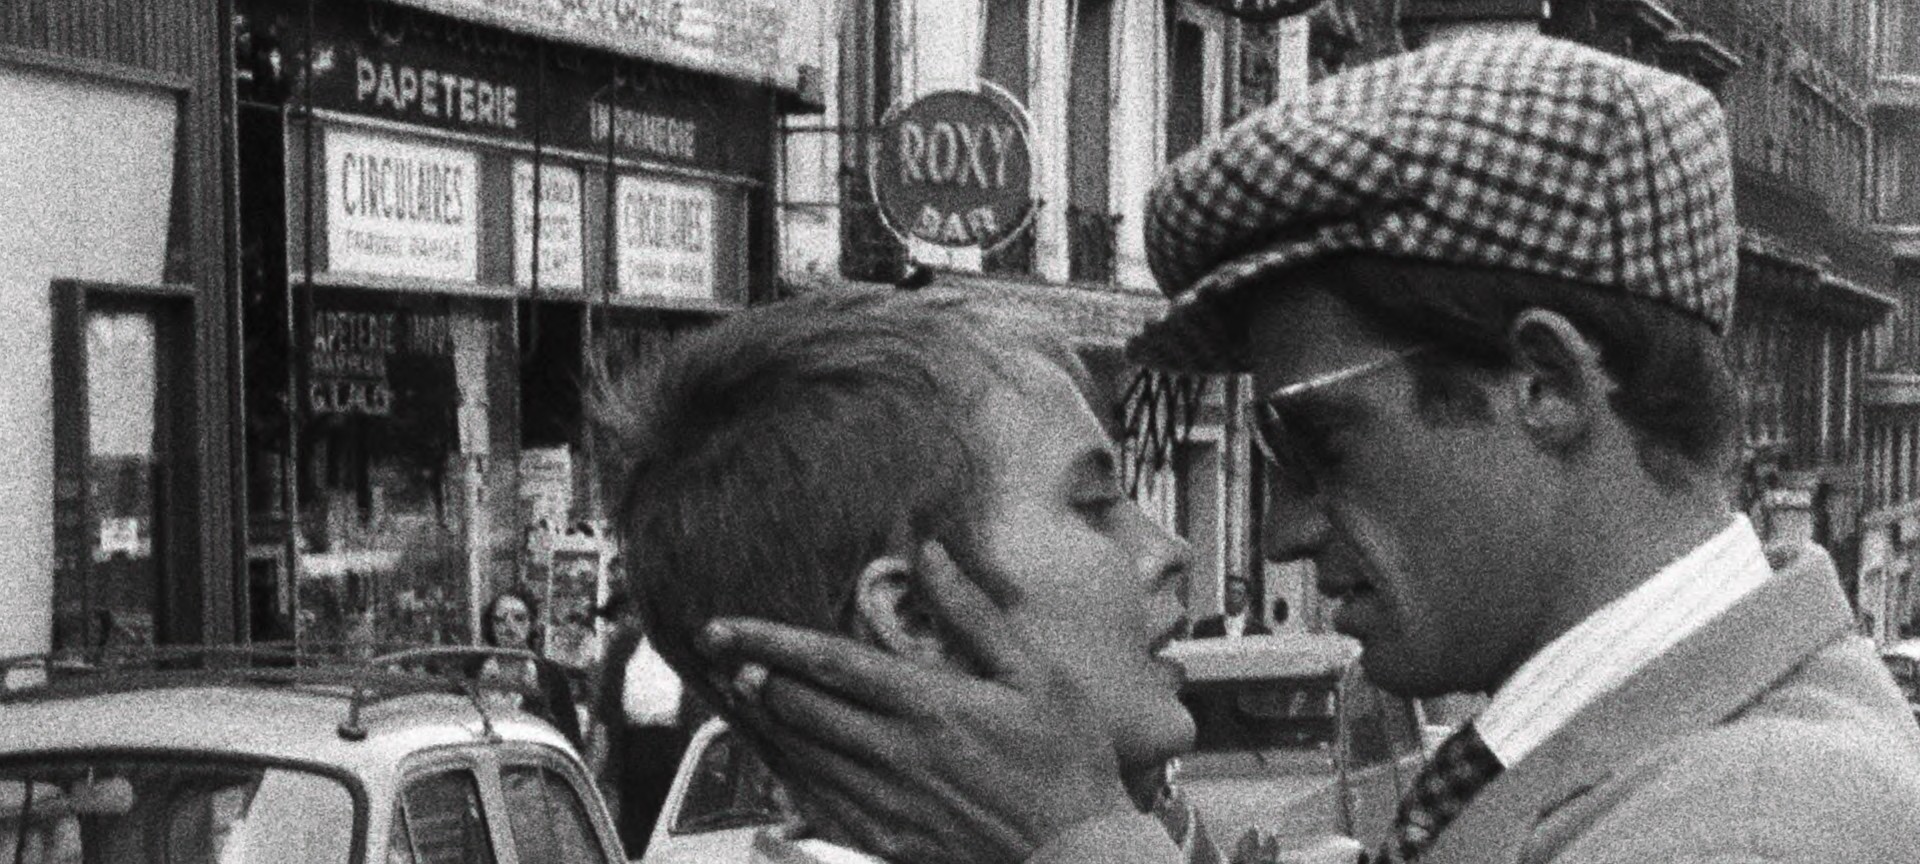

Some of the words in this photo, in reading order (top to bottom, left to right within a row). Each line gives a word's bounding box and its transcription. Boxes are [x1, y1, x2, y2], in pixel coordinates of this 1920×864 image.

[356, 57, 517, 129] PAPETERIE
[899, 121, 1015, 188] ROXY
[342, 152, 463, 225] CIRCULAIRES
[912, 204, 999, 242] BAR
[312, 310, 396, 354] APETERIE
